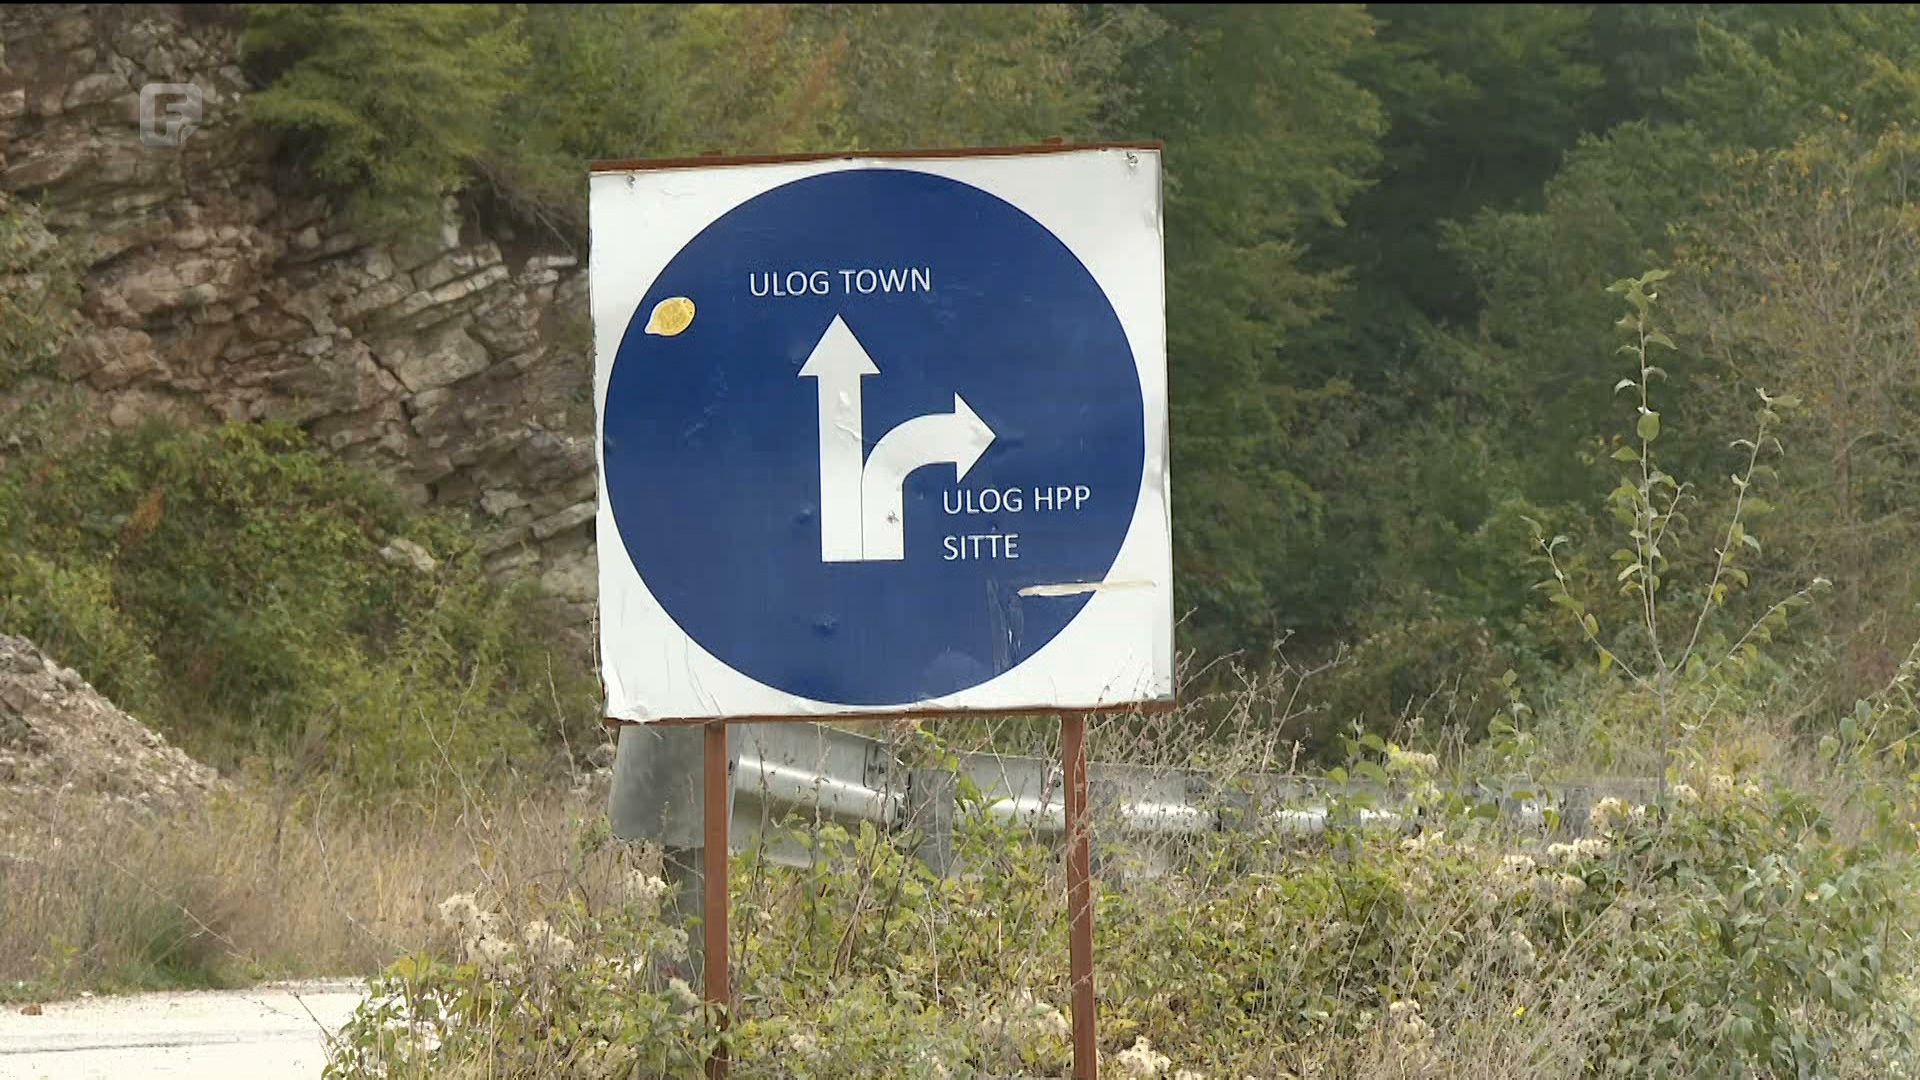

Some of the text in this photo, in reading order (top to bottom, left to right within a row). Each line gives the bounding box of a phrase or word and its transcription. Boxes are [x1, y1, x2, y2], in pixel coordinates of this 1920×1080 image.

[750, 268, 931, 297] ULOG TOWN
[943, 485, 1091, 515] ULOG HPP
[942, 533, 1019, 561] SITTE
